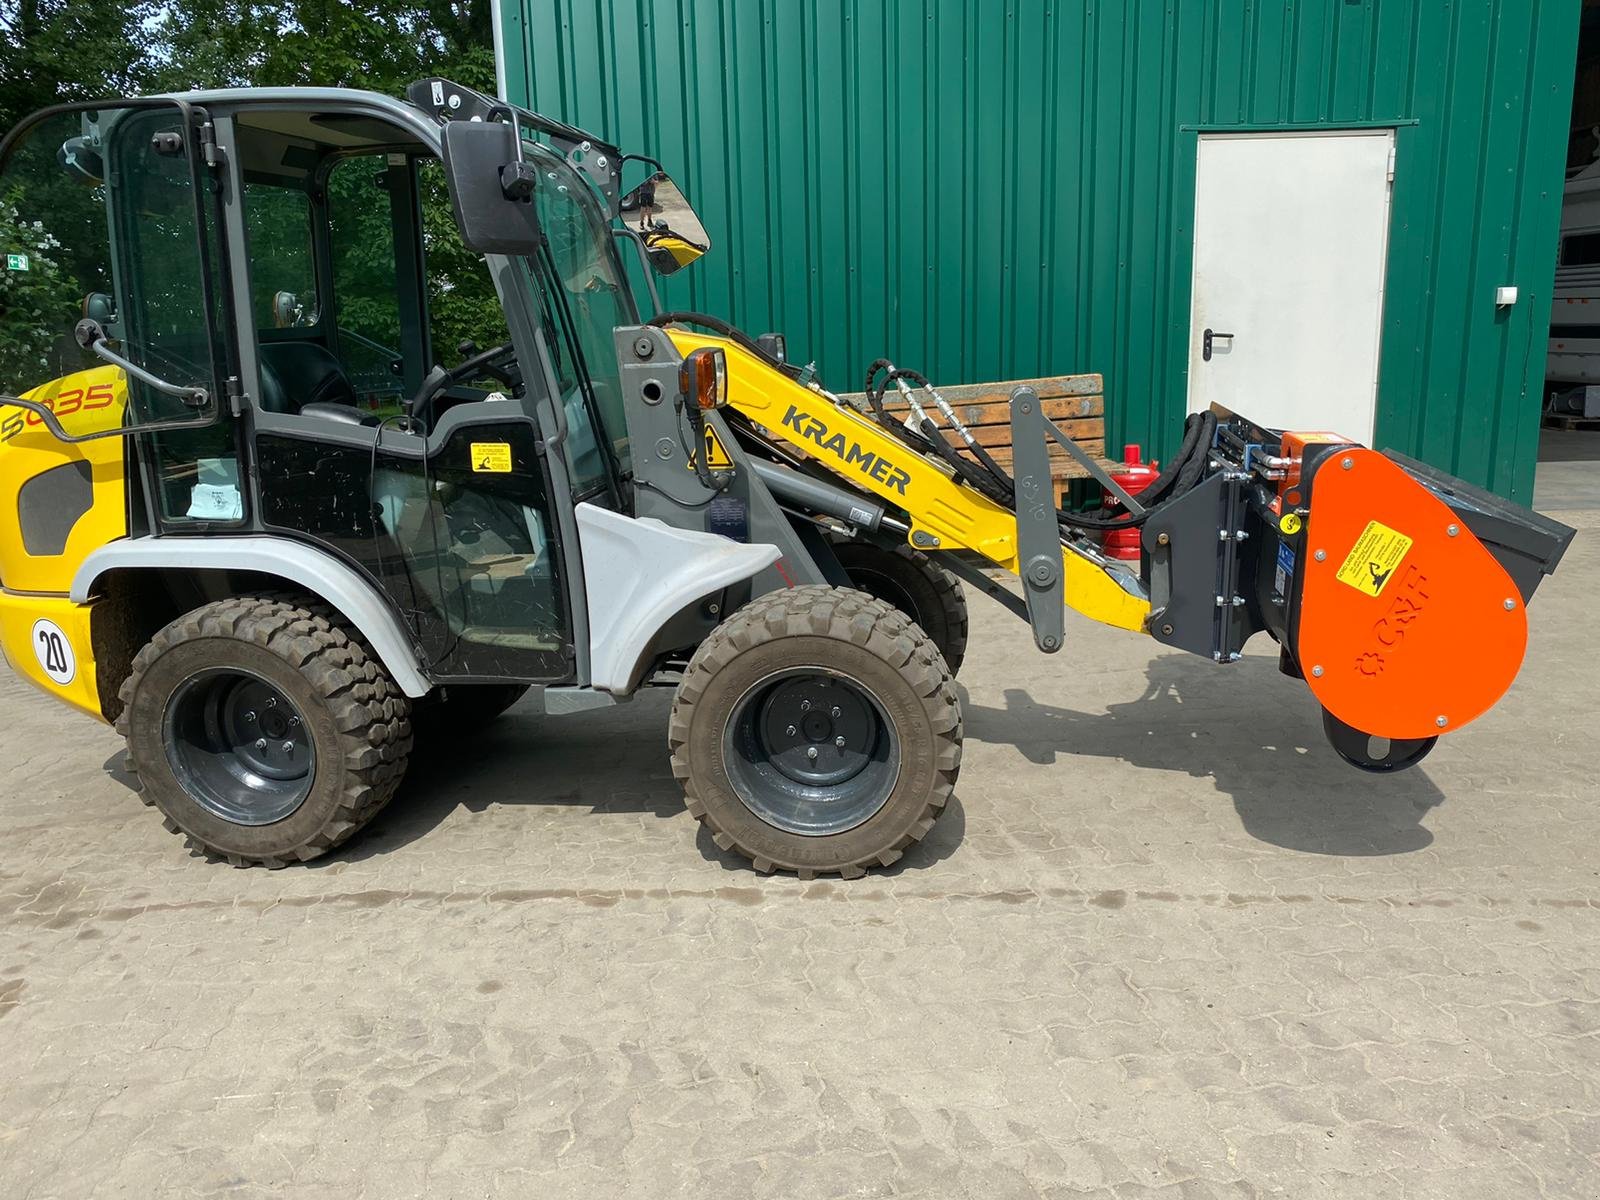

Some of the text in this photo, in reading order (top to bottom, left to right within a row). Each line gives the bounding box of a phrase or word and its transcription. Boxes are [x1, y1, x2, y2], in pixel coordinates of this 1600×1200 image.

[781, 404, 912, 496] KRAMER
[1345, 553, 1355, 566] LAND
[39, 630, 68, 673] 20
